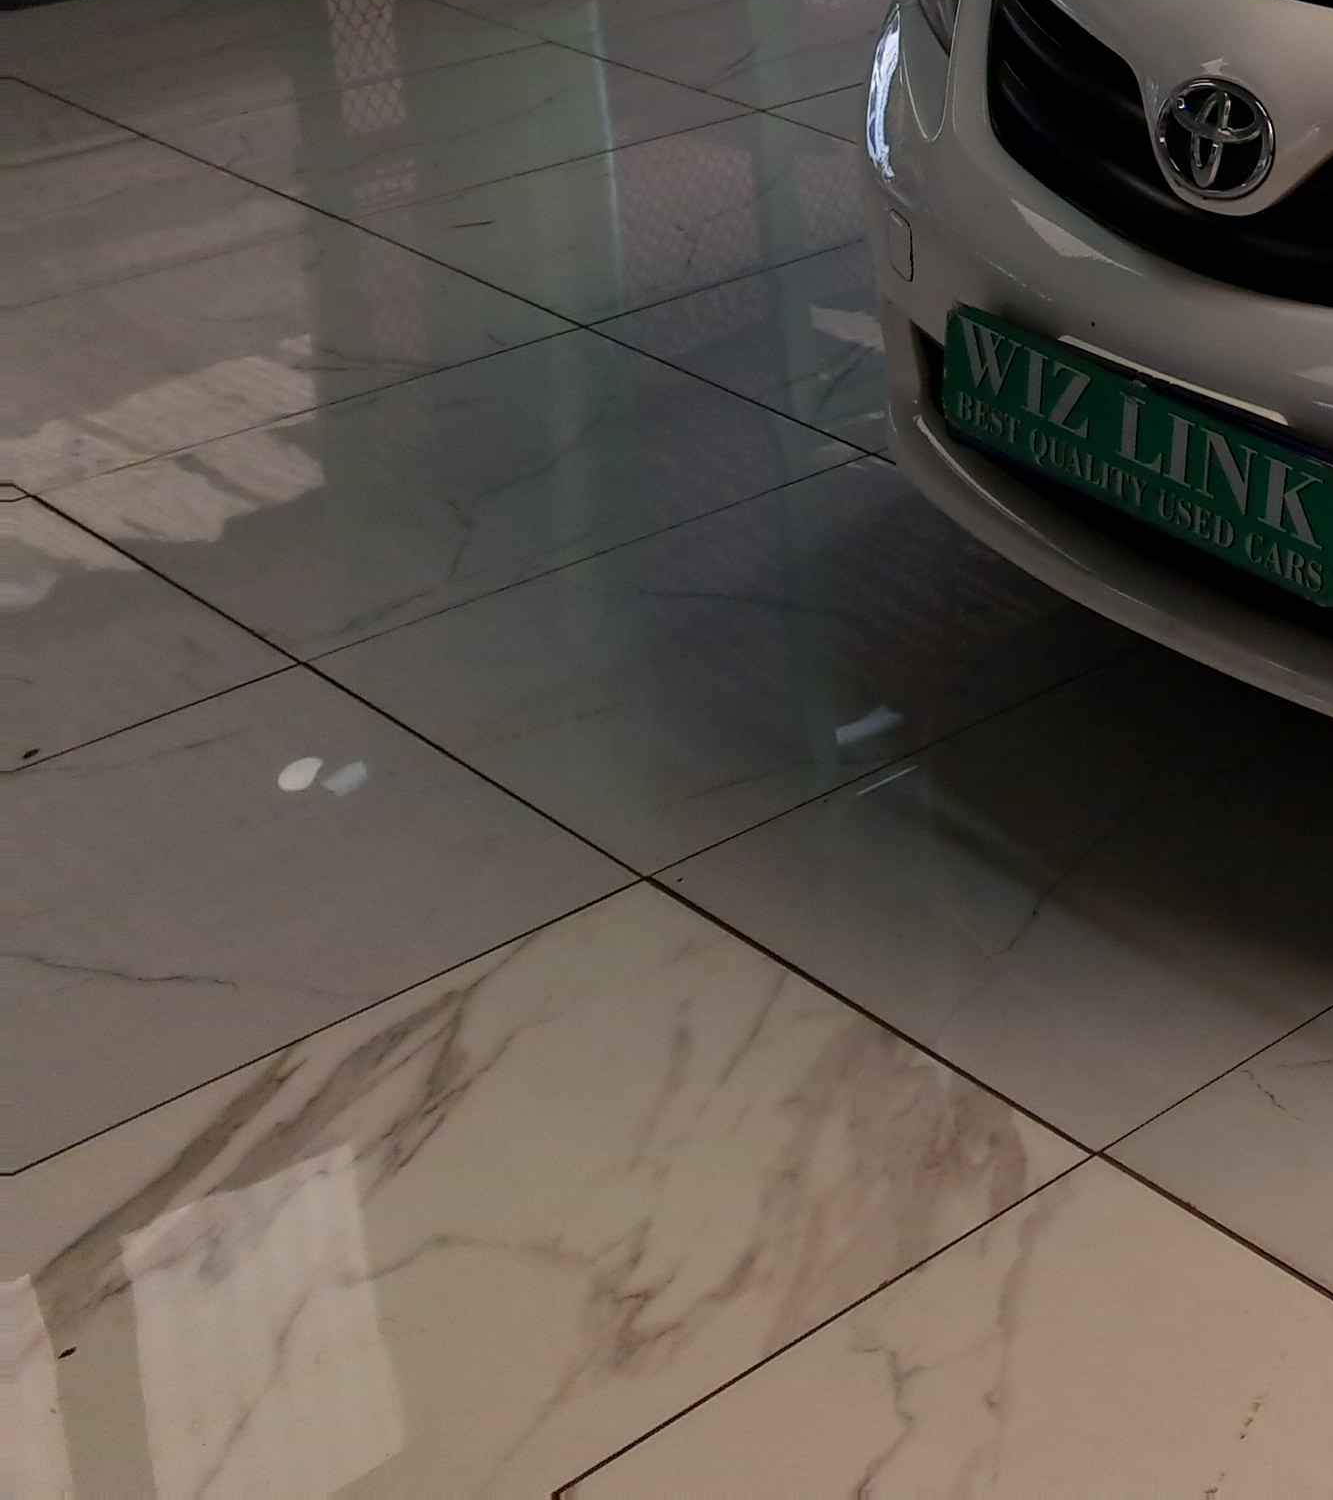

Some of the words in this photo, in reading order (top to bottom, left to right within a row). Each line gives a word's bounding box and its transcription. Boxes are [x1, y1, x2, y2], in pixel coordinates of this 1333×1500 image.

[958, 391, 1023, 445] BEST
[1033, 428, 1149, 507] QUALITY
[1158, 488, 1236, 549] USED
[1245, 532, 1325, 593] CARS
[959, 317, 1092, 439] WIZ
[1118, 388, 1324, 551] LINK
